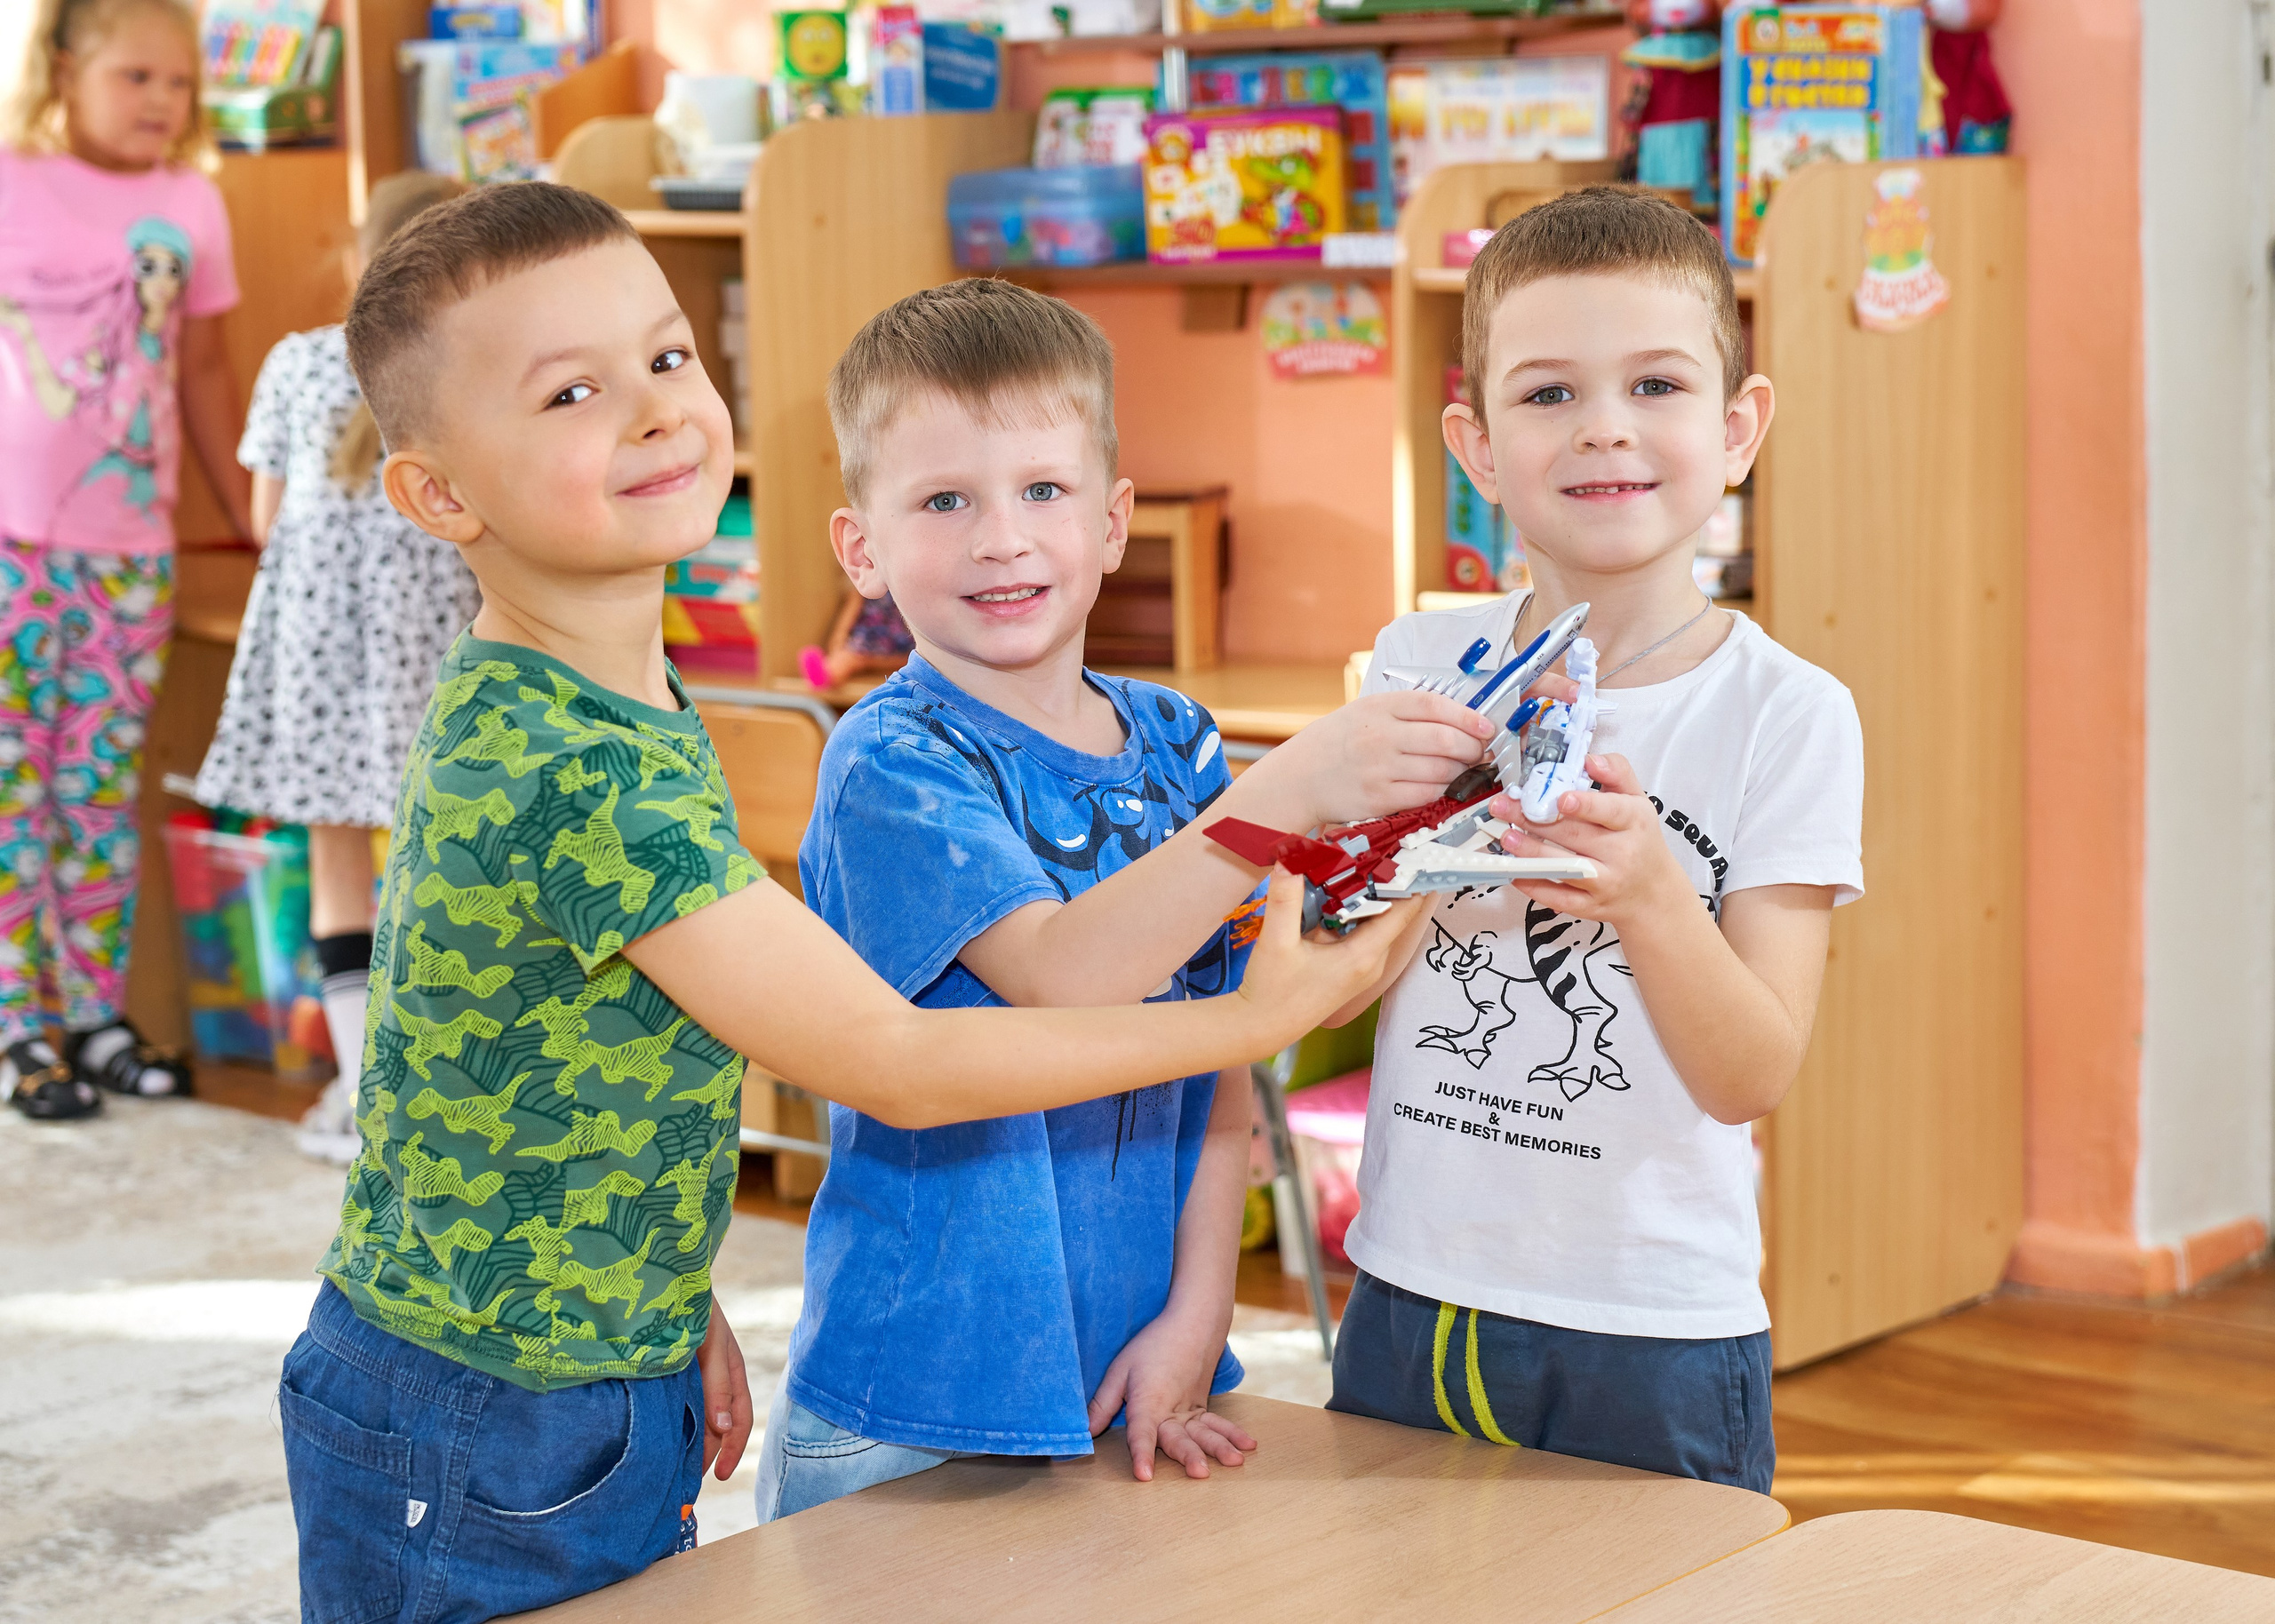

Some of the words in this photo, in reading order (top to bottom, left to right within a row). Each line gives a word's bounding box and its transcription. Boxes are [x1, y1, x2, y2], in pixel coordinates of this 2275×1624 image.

[1434, 1081, 1476, 1103] JUST
[1478, 1092, 1522, 1114] HAVE
[1526, 1102, 1564, 1121] FUN
[1489, 1111, 1501, 1126] &
[1393, 1102, 1457, 1131] CREATE
[1460, 1120, 1502, 1142] BEST
[1505, 1131, 1601, 1160] MEMORIES
